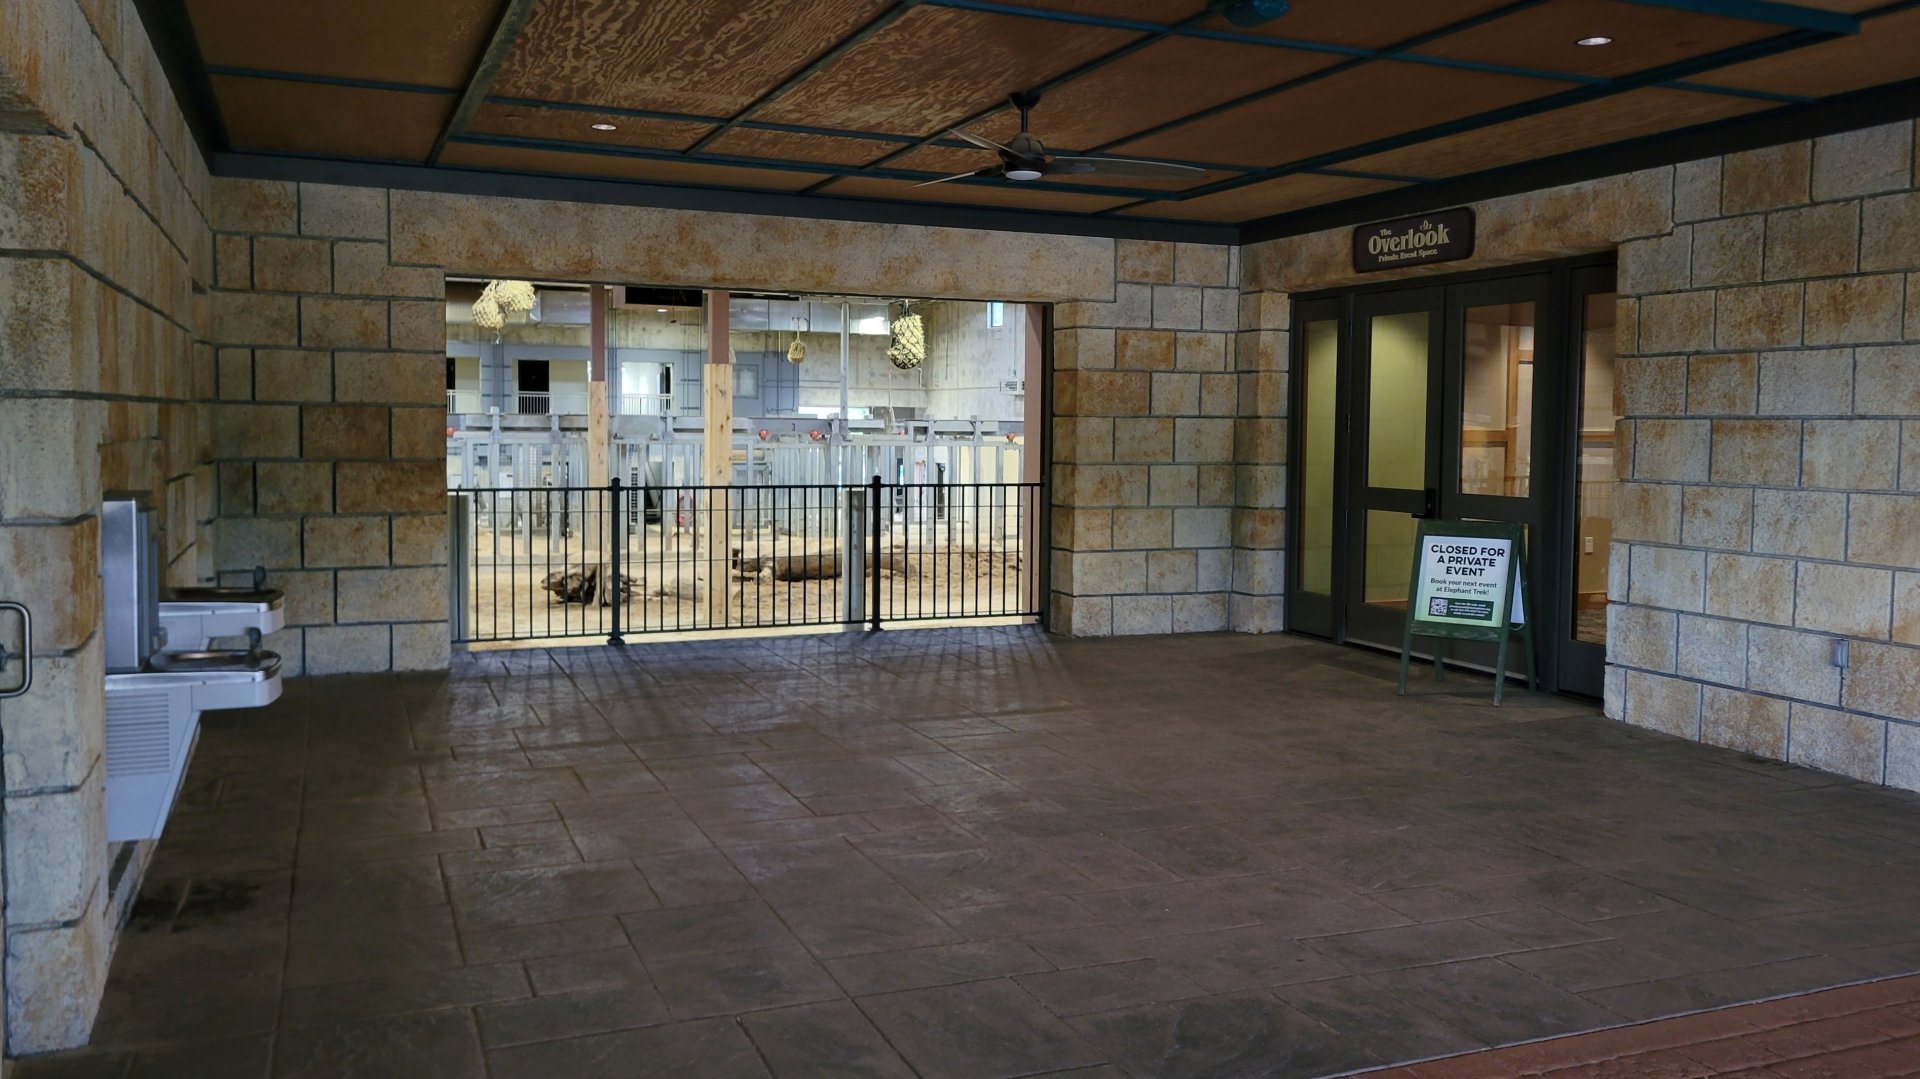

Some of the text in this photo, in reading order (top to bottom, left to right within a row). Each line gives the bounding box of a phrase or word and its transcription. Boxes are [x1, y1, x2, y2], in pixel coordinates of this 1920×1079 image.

[1368, 224, 1450, 254] Overlook
[1378, 248, 1438, 262] Private Event Space
[1431, 544, 1505, 557] CLOSED FOR
[1437, 556, 1496, 567] A PRIVATE
[1446, 566, 1485, 576] EVENT
[1444, 586, 1472, 594] Elephant
